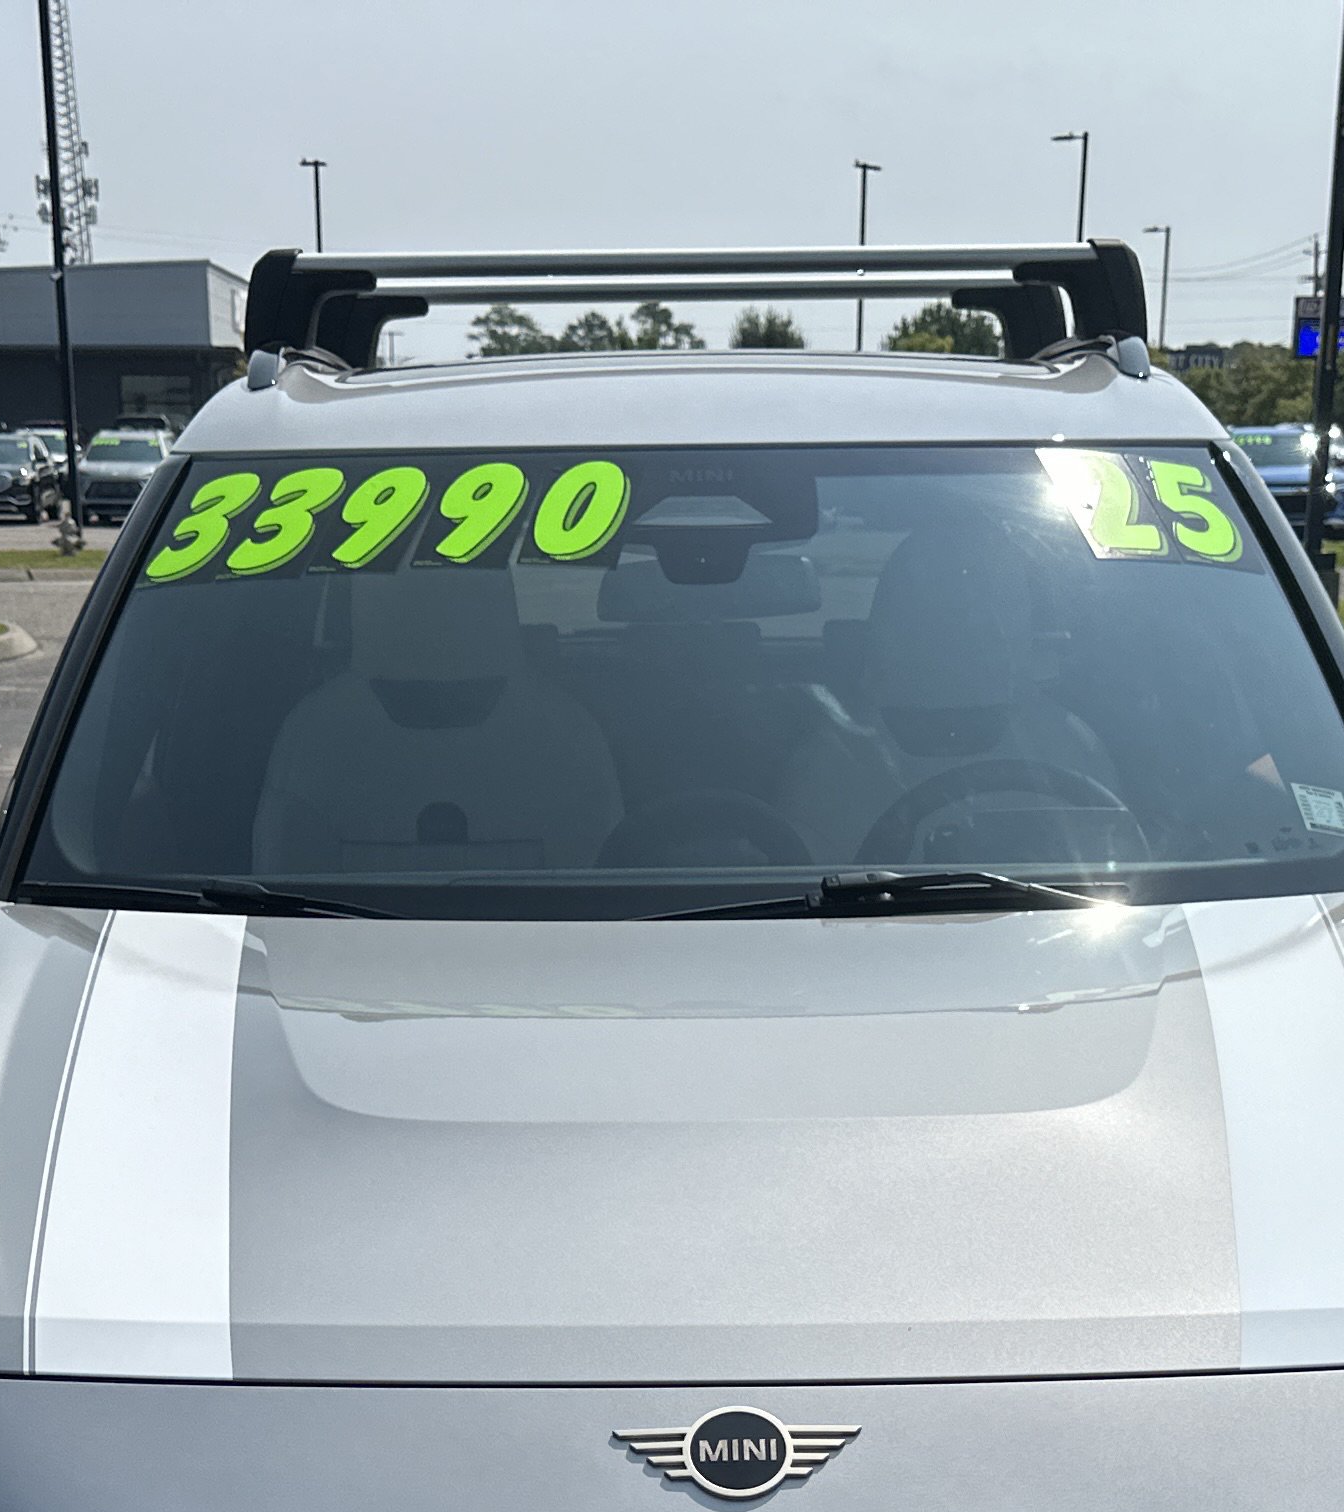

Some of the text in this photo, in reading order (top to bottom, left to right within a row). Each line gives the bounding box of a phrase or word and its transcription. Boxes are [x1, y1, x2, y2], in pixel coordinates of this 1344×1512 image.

[145, 456, 1244, 582] 33990 25
[699, 1438, 777, 1462] MINI
